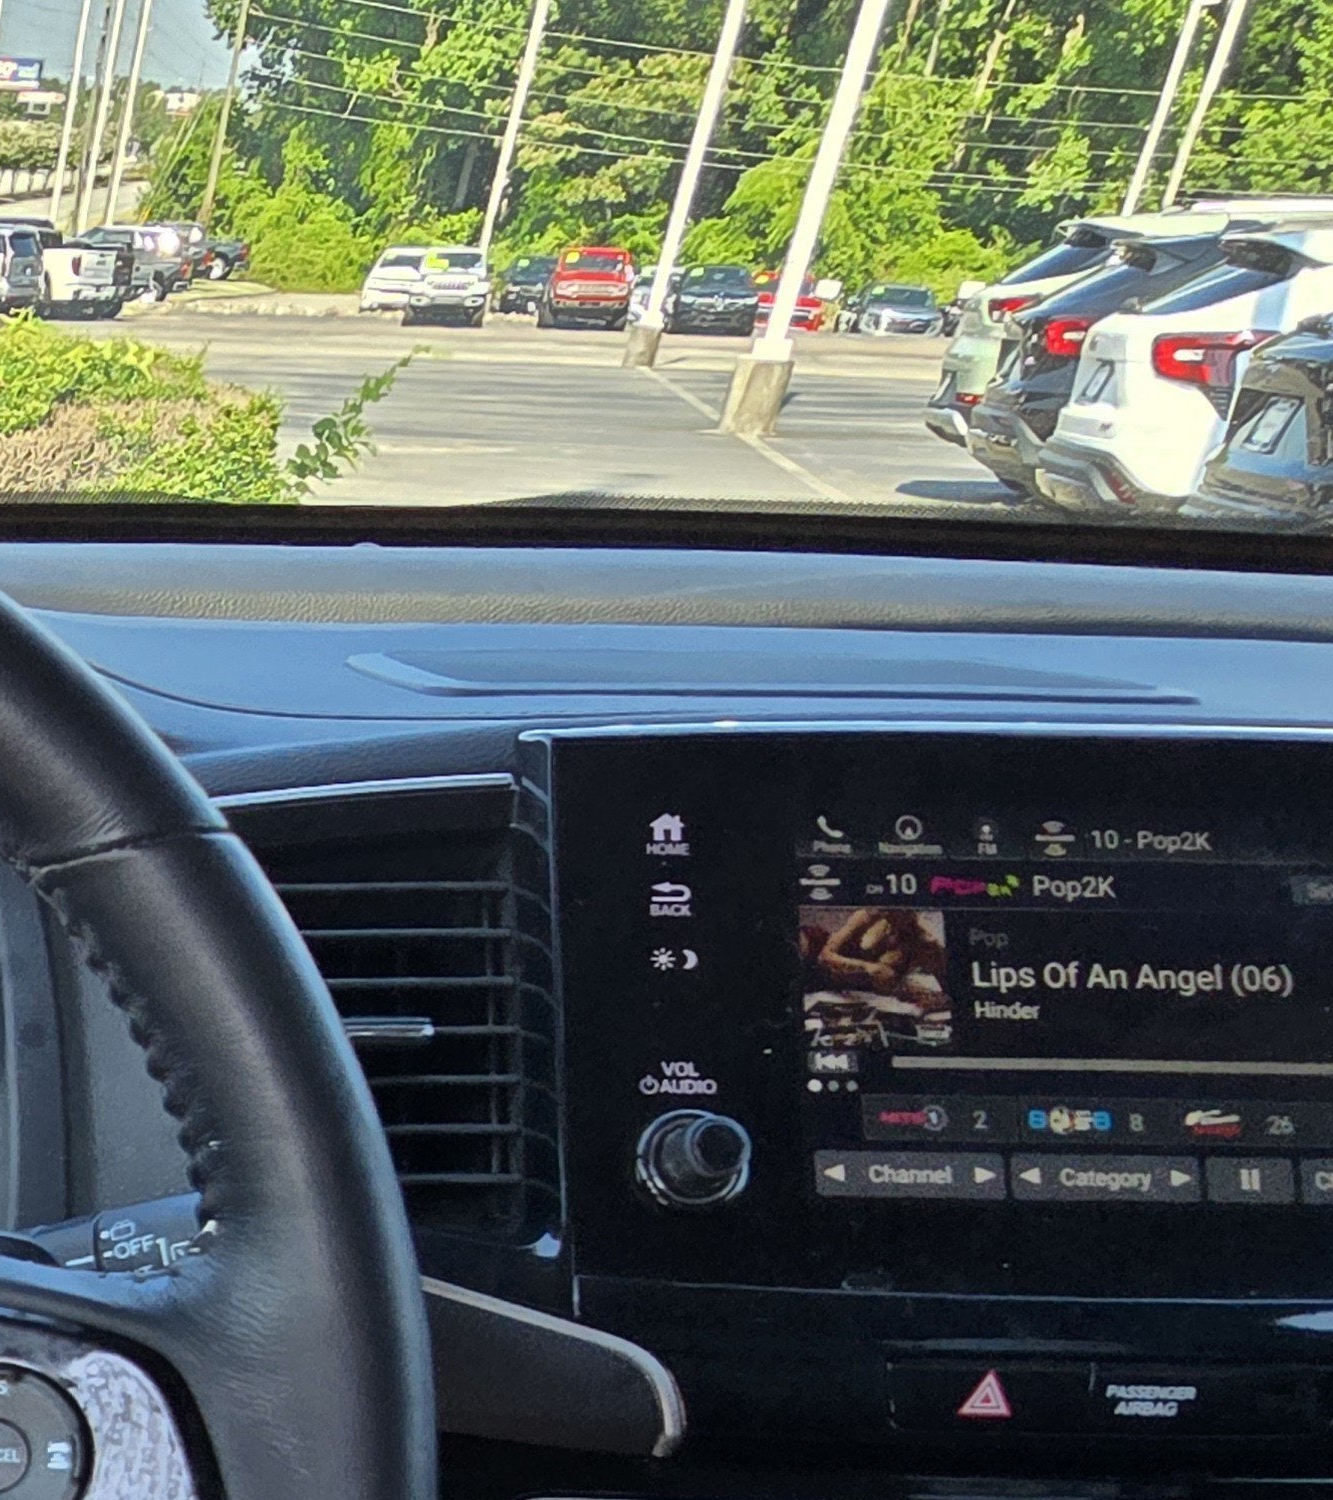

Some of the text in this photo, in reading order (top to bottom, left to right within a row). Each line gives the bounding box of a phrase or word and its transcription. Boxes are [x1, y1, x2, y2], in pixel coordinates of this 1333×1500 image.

[646, 843, 690, 856] HOME
[1091, 830, 1119, 850] 10
[1137, 831, 1213, 854] Pop2K
[886, 875, 917, 896] 10
[1032, 875, 1117, 901] Pop2K
[649, 903, 692, 917] BACK
[968, 928, 1010, 950] Pop
[971, 961, 1294, 997] Lips Of An Angel (06)
[974, 1000, 1041, 1020] Hinder
[660, 1061, 701, 1078] VOL
[659, 1078, 718, 1095] AUDIO
[973, 1110, 989, 1130] 2
[868, 1164, 953, 1186] Channel
[1059, 1167, 1152, 1192] Category
[113, 1233, 155, 1260] OFF
[1105, 1384, 1197, 1401] PASSENGER
[1113, 1400, 1179, 1417] AIRBAG
